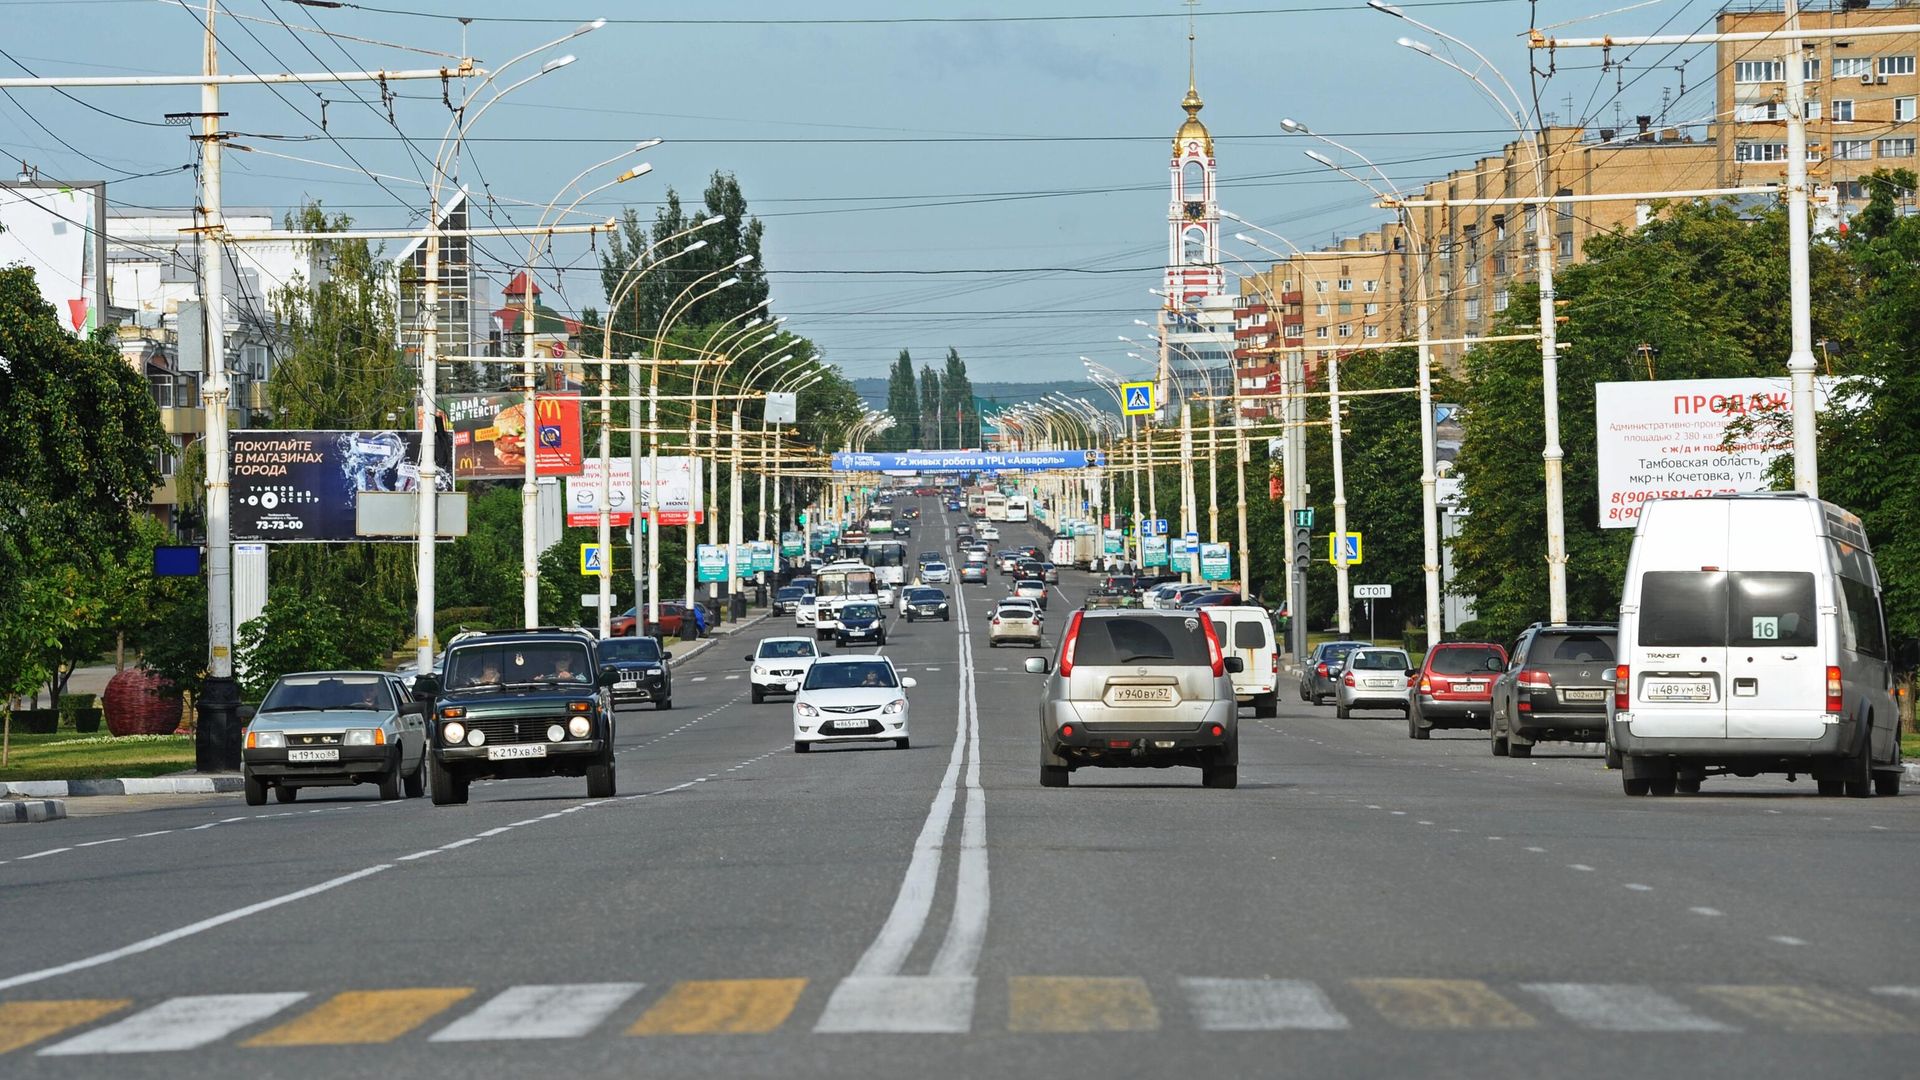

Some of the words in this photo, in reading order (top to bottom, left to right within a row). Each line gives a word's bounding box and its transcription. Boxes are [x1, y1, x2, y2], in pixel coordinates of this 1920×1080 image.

[1673, 392, 1796, 417] ПРОДАЖ
[1674, 432, 1681, 441] 2
[1684, 431, 1700, 441] 380
[234, 438, 312, 452] ПОКУПАЙТЕ
[234, 453, 243, 463] В
[245, 453, 324, 463] МАГАЗИНАХ
[894, 457, 907, 466] 72
[908, 457, 941, 466] живых
[942, 456, 976, 467] робота
[985, 455, 1006, 466] ТРЦ
[1007, 455, 1065, 466] «Акварель»
[1638, 457, 1709, 470] Тамбовская
[1712, 455, 1764, 468] область,
[234, 465, 288, 477] ГОРОДА
[1629, 475, 1664, 485] мкр-н
[1667, 471, 1734, 483] Кочетовка,
[1738, 473, 1756, 483] ул.
[256, 520, 304, 530] 73-73-00
[1359, 587, 1386, 596] СТОП
[1755, 622, 1775, 638] 16
